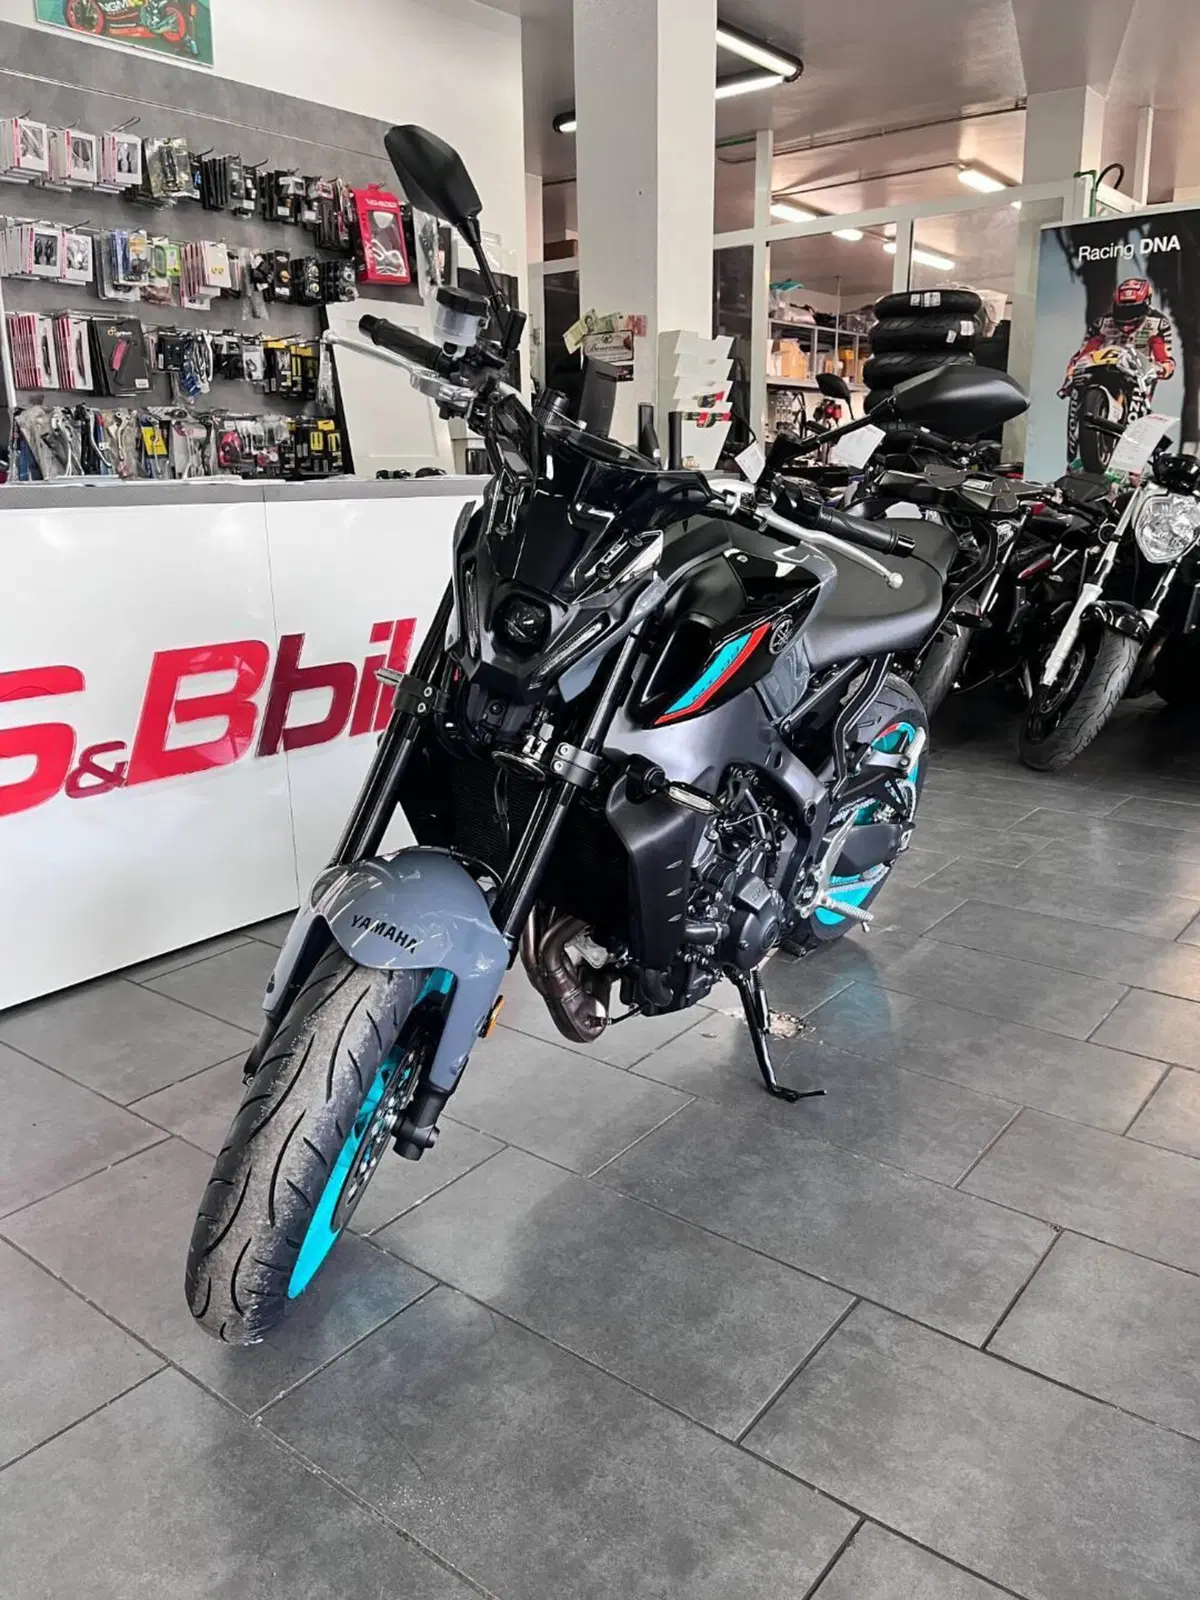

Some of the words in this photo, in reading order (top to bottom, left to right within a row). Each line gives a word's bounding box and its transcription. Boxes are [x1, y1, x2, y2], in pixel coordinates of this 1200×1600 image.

[1078, 242, 1134, 261] Racing
[1140, 235, 1180, 254] DNA
[1127, 386, 1144, 424] rizo
[351, 914, 418, 954] YAMAHA
